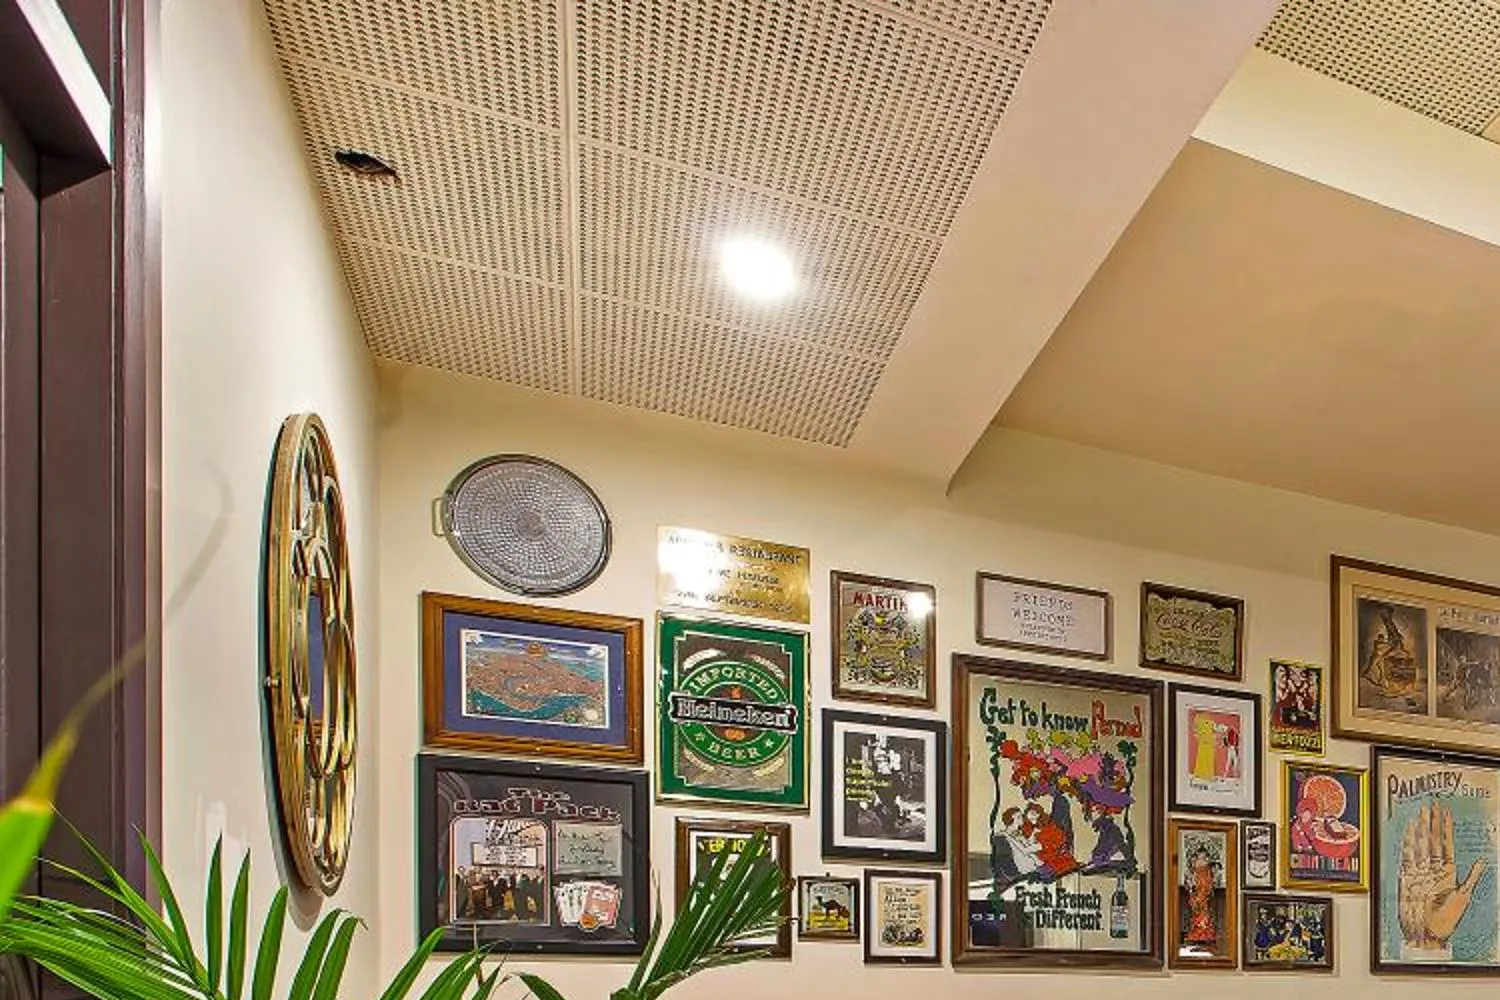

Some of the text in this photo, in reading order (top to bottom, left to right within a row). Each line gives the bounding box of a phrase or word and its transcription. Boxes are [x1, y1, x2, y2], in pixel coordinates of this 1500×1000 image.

[690, 666, 779, 700] IMPORTED
[676, 697, 791, 727] Heineken
[979, 687, 1016, 725] Get
[1019, 699, 1039, 727] to
[1041, 701, 1089, 732] know
[708, 741, 762, 761] BEER
[1387, 771, 1463, 821] PALMISTRY
[1015, 885, 1102, 910] Fresh French
